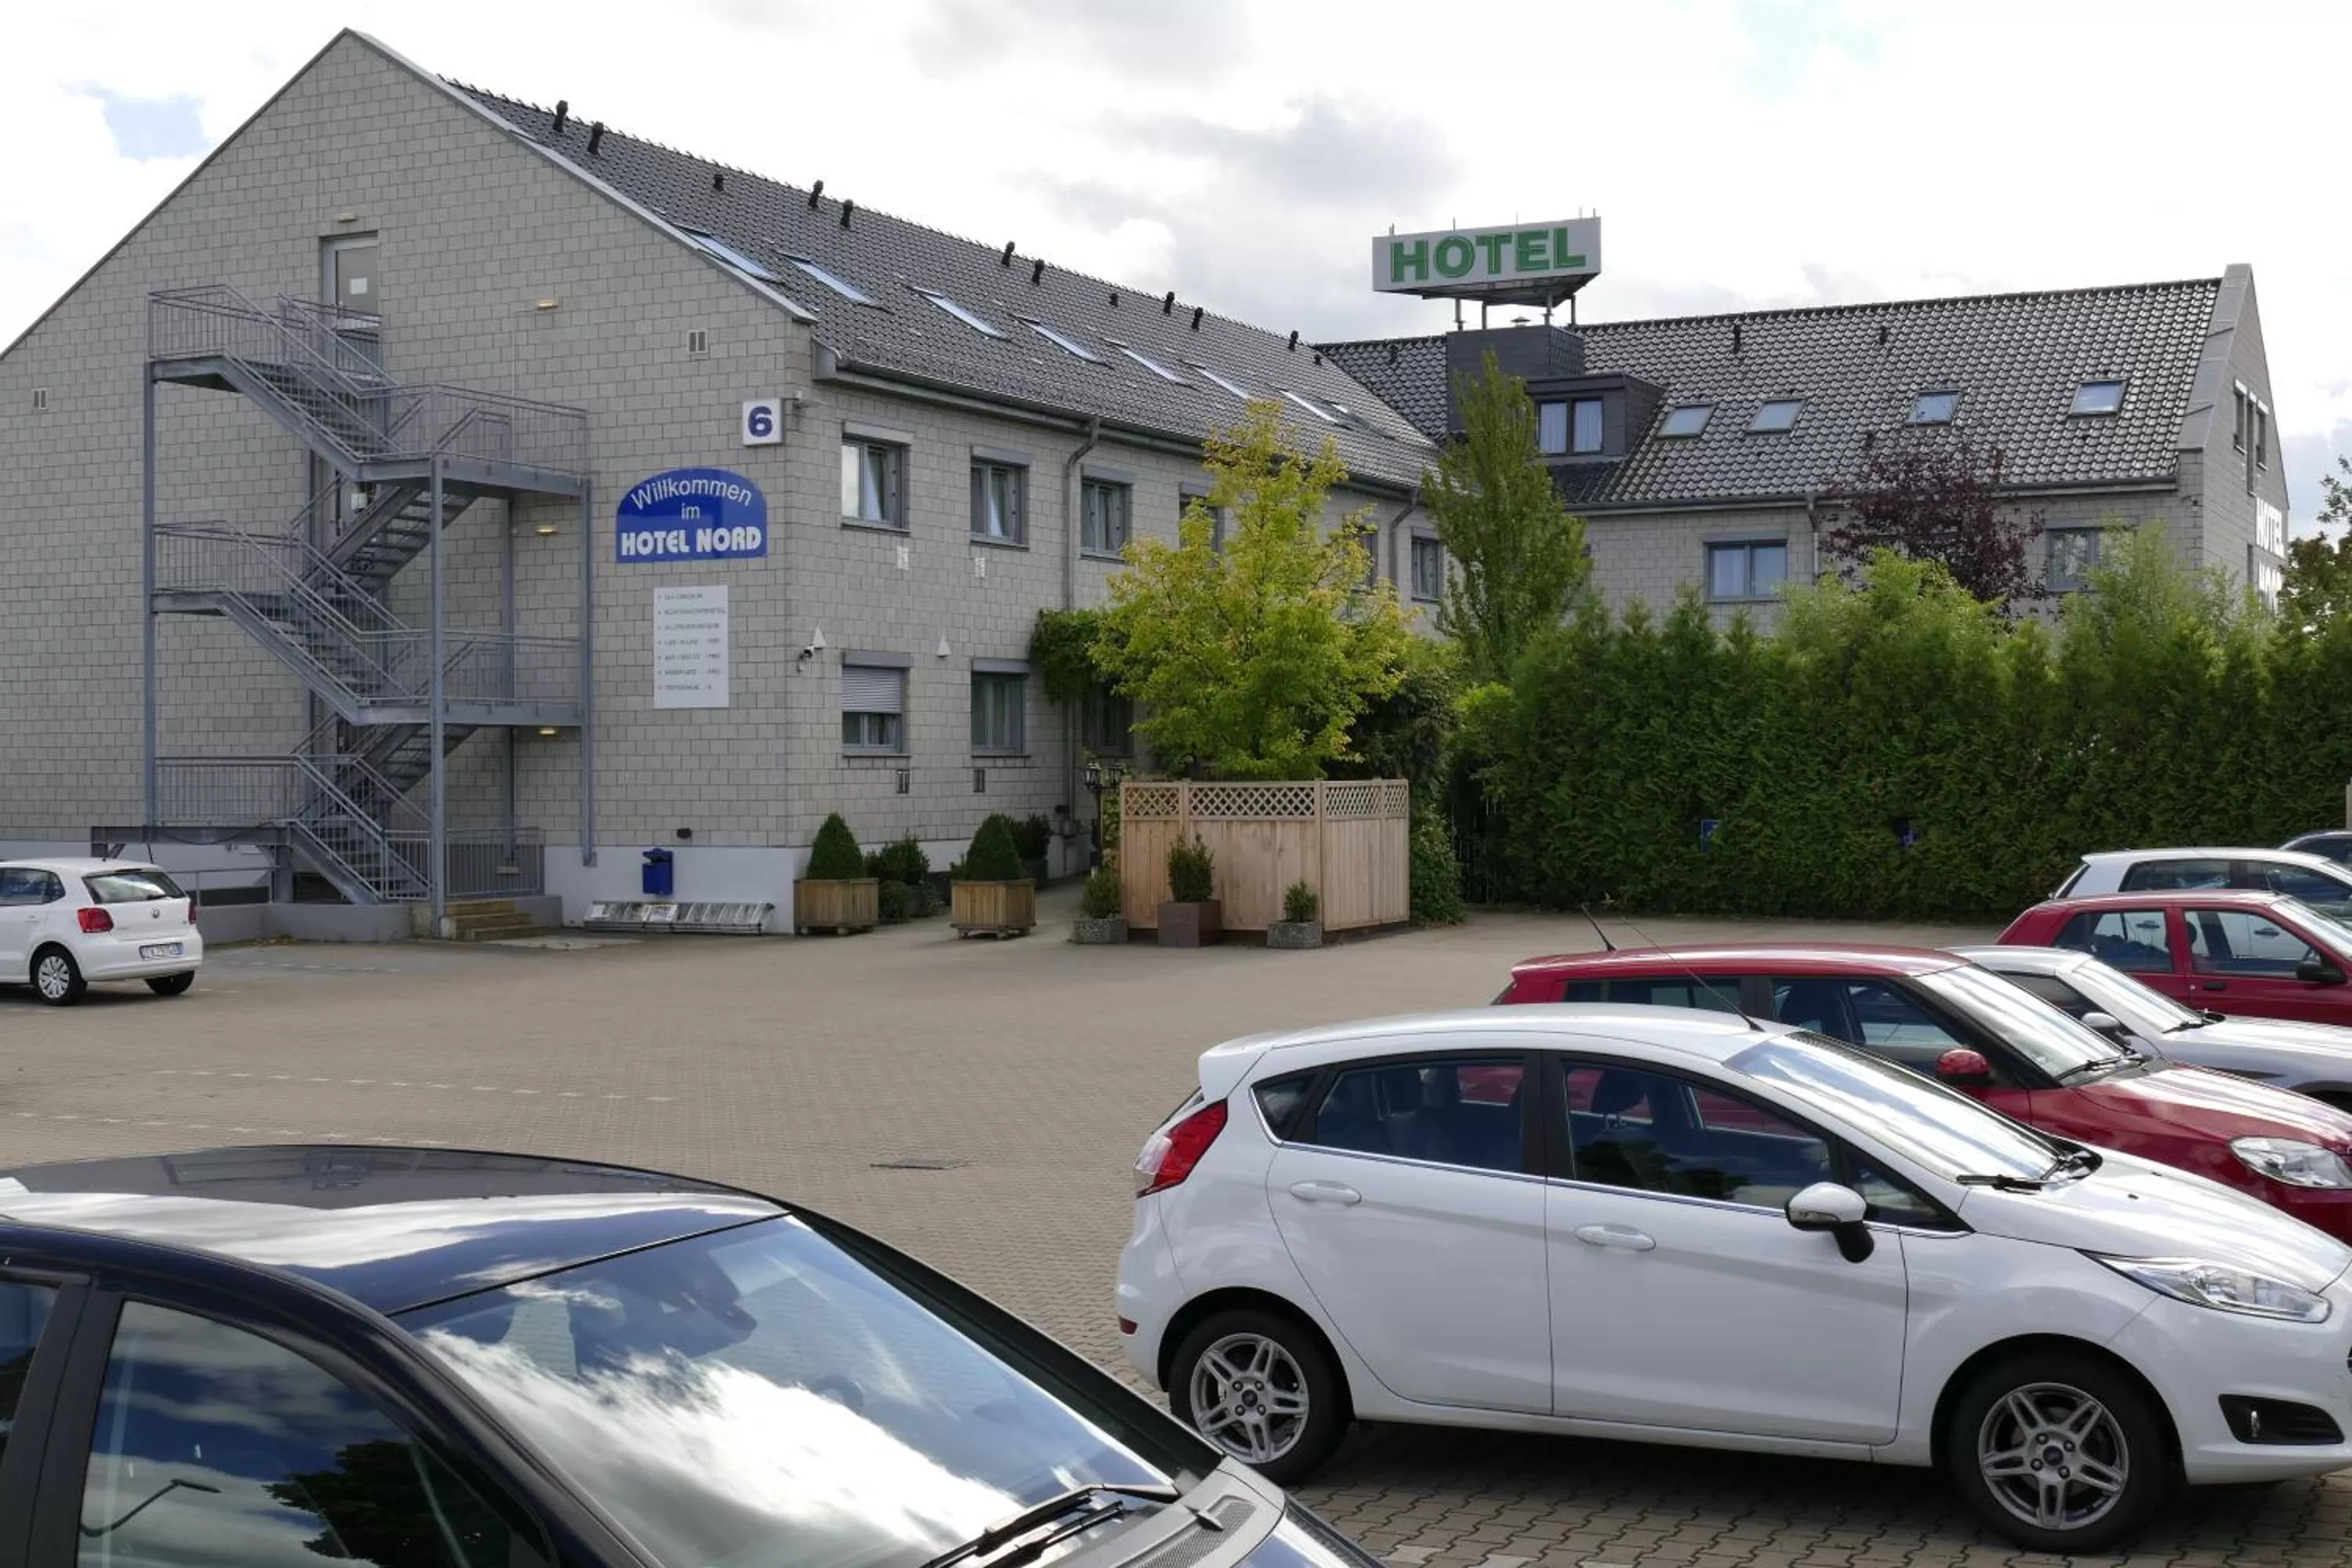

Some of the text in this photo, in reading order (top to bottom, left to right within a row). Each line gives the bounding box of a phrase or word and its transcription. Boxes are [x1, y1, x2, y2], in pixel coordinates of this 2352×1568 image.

[1390, 227, 1586, 283] HOTEL
[747, 405, 773, 437] 6
[630, 477, 753, 510] Willkommen
[681, 503, 700, 520] im
[621, 526, 762, 557] HOTEL NORD
